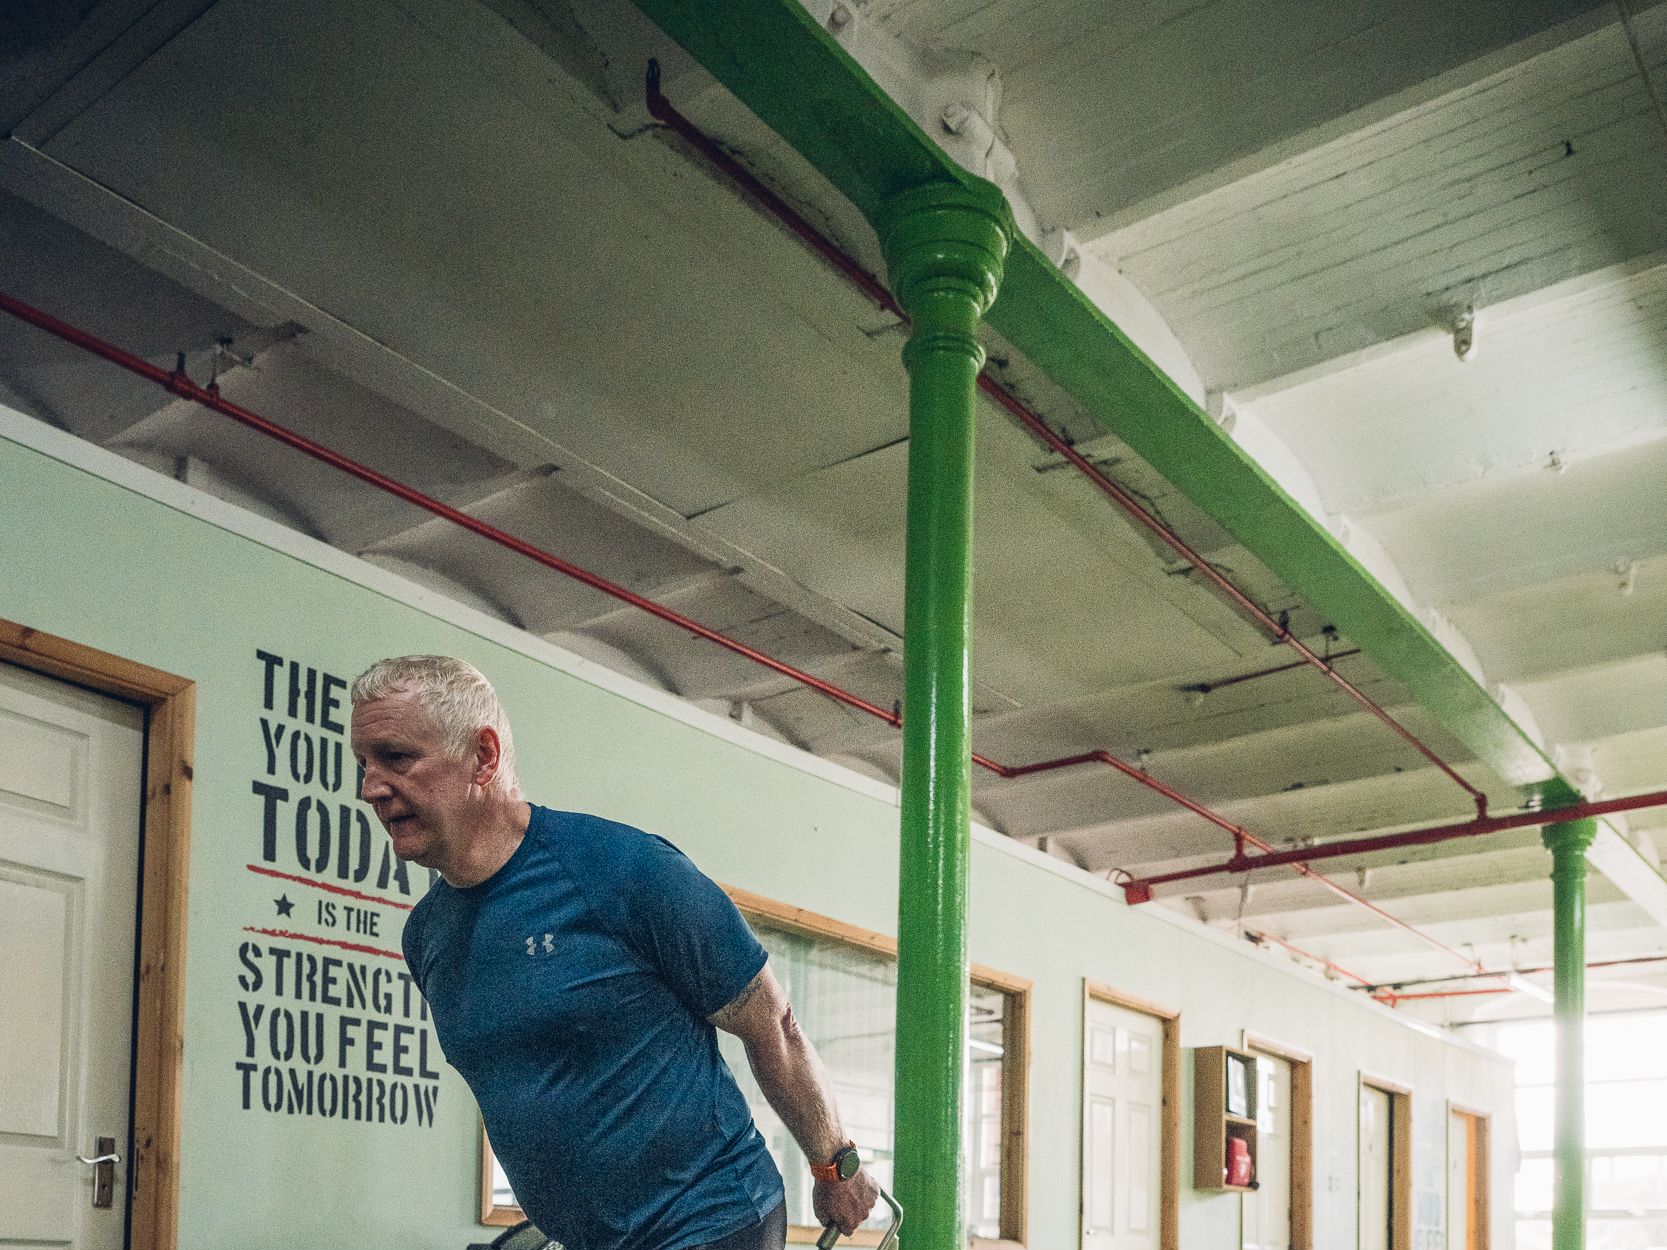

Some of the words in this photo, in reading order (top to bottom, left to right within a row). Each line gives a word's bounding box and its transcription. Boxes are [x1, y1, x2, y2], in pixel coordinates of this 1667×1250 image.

[256, 649, 348, 736] THE
[259, 717, 343, 794] YOU
[252, 780, 440, 897] TODA
[317, 899, 337, 928] IS
[343, 905, 381, 939] THE
[237, 1001, 325, 1067] YOU
[338, 1015, 440, 1080] FEEL
[235, 1061, 439, 1129] TOMORROW
